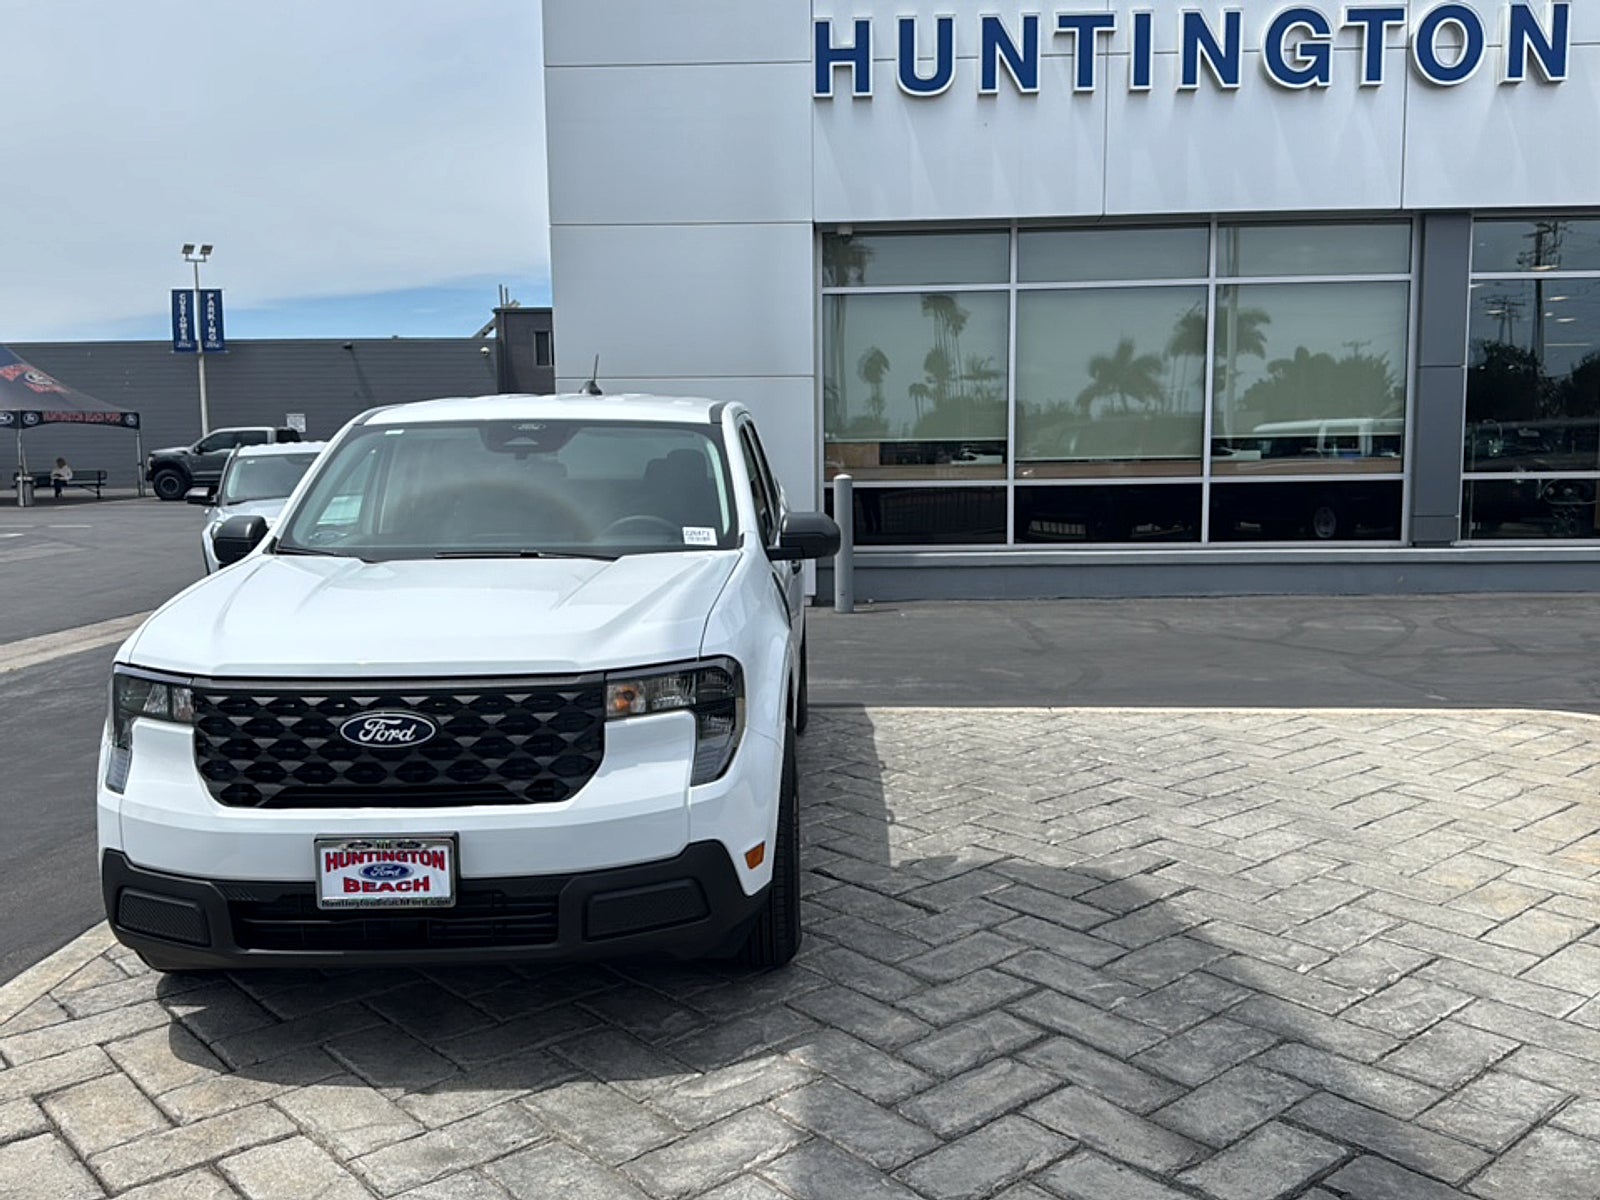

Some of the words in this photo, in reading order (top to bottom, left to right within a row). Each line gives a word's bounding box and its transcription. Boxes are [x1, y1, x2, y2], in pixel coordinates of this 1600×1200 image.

[813, 2, 1570, 98] HUNTINGTON
[179, 293, 188, 341] CUSTOMER
[207, 293, 217, 342] PARKING
[358, 718, 417, 742] Ford
[325, 850, 446, 873] HUNTINGTON
[370, 865, 401, 878] Ford
[343, 875, 431, 893] BEACH
